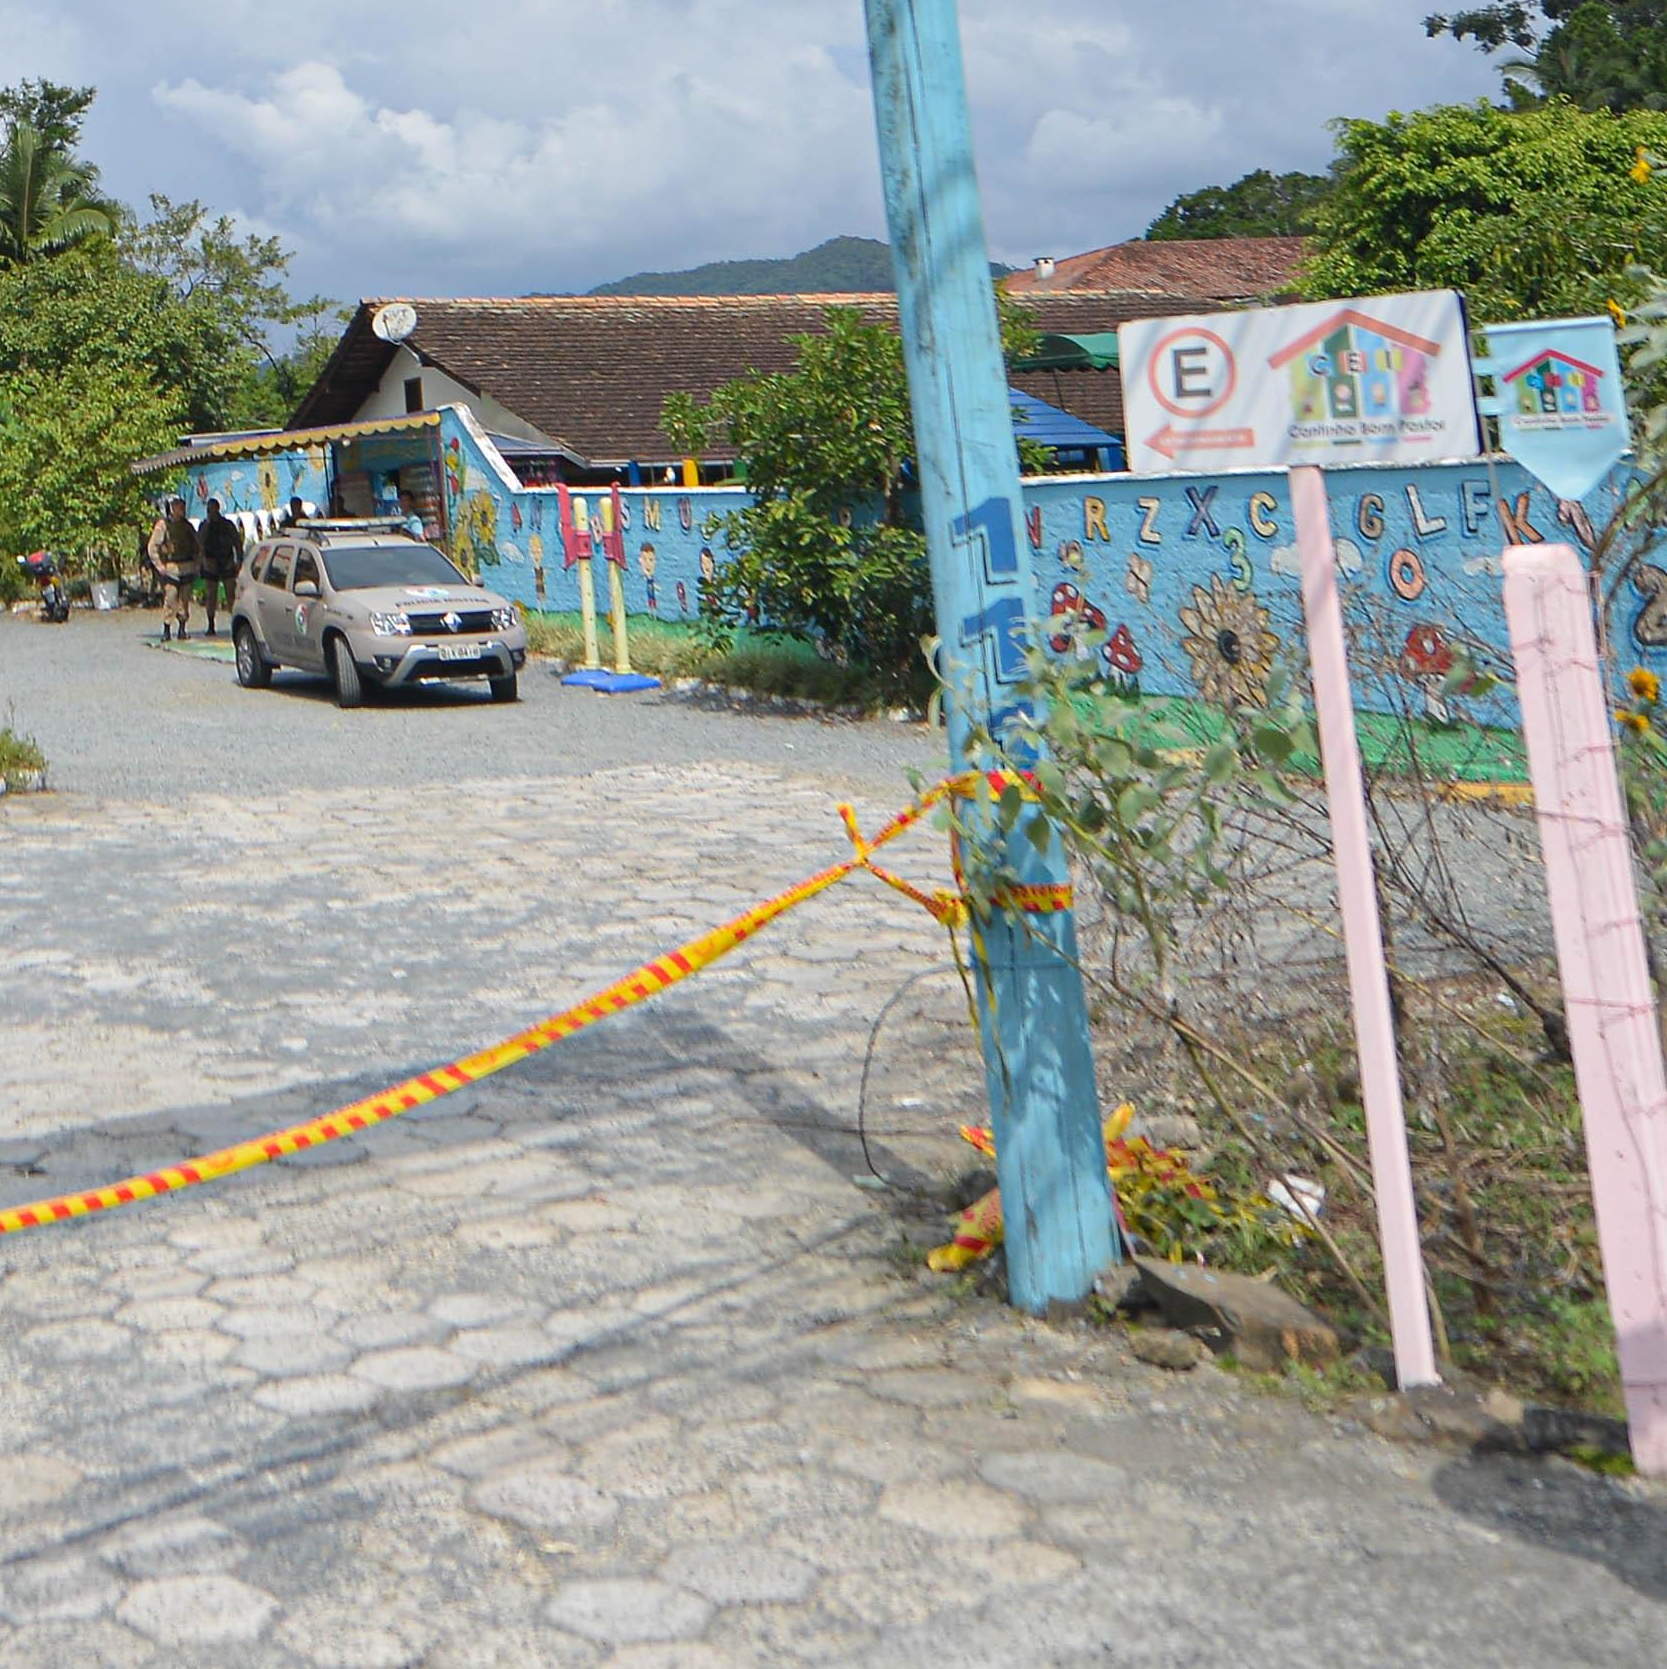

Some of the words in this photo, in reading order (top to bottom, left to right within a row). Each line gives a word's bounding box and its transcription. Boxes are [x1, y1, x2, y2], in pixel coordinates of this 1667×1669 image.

[1173, 348, 1212, 399] E
[1083, 495, 1110, 543] R
[1138, 496, 1162, 544] Z
[1185, 486, 1219, 538] X
[1249, 491, 1279, 538] C
[1405, 484, 1447, 536] L
